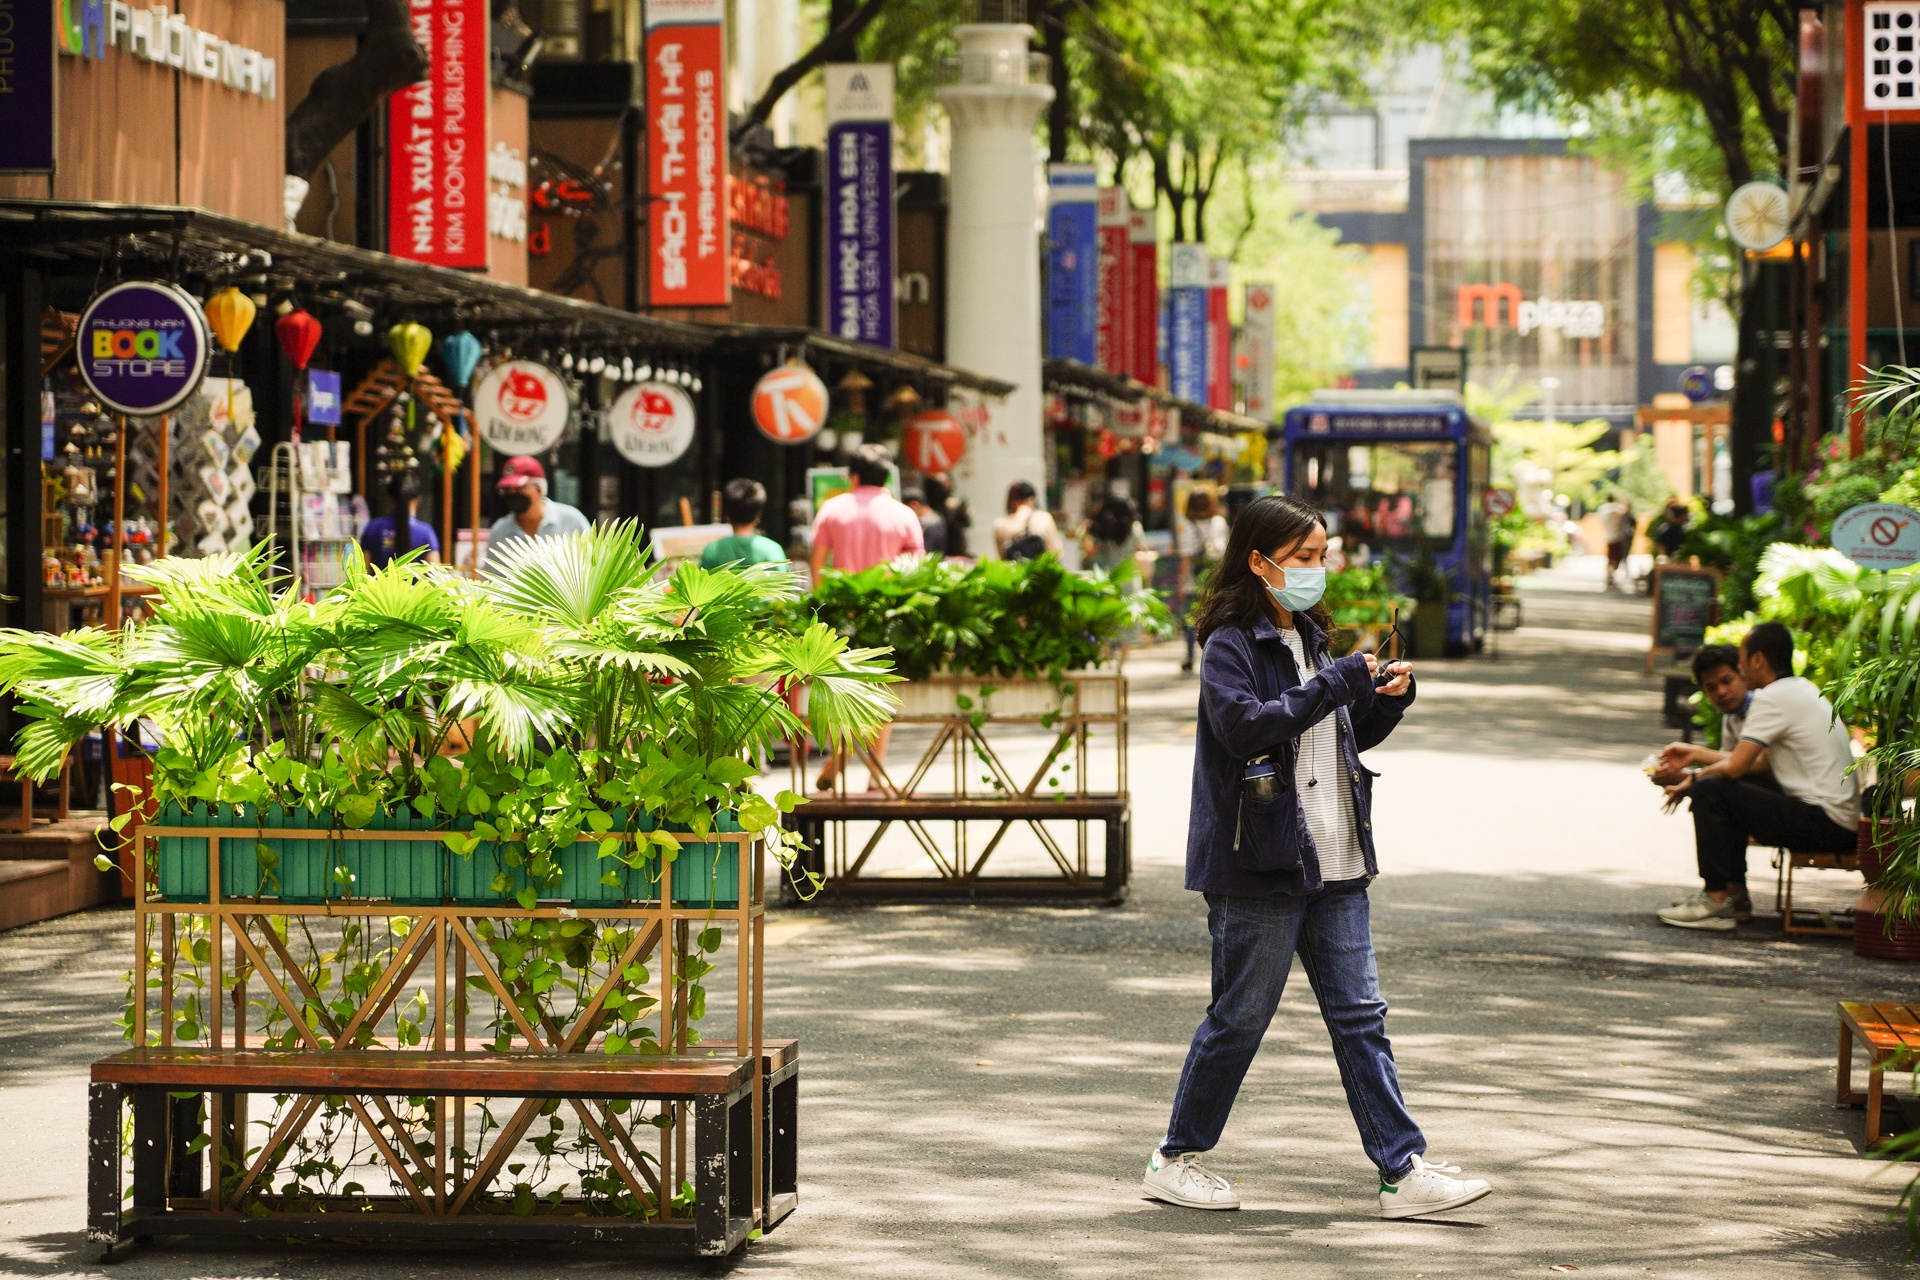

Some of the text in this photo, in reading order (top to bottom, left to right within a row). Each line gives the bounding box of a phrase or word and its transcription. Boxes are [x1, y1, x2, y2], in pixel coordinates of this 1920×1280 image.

[223, 40, 276, 100] NAM
[442, 10, 466, 134] PUBLISHING
[403, 123, 434, 194] XUẤT
[443, 138, 466, 208] DONG
[654, 43, 687, 290] SÁCH THÁI HÀ
[694, 69, 717, 260] THAIHABOOKS
[838, 132, 860, 179] SEN
[839, 182, 860, 236] HOA
[861, 131, 881, 249] UNIVERSITY
[407, 197, 434, 255] NHÀ
[444, 212, 465, 255] KIM
[92, 329, 185, 360] BOOK
[153, 318, 185, 329] NAM
[92, 359, 186, 378] STORE
